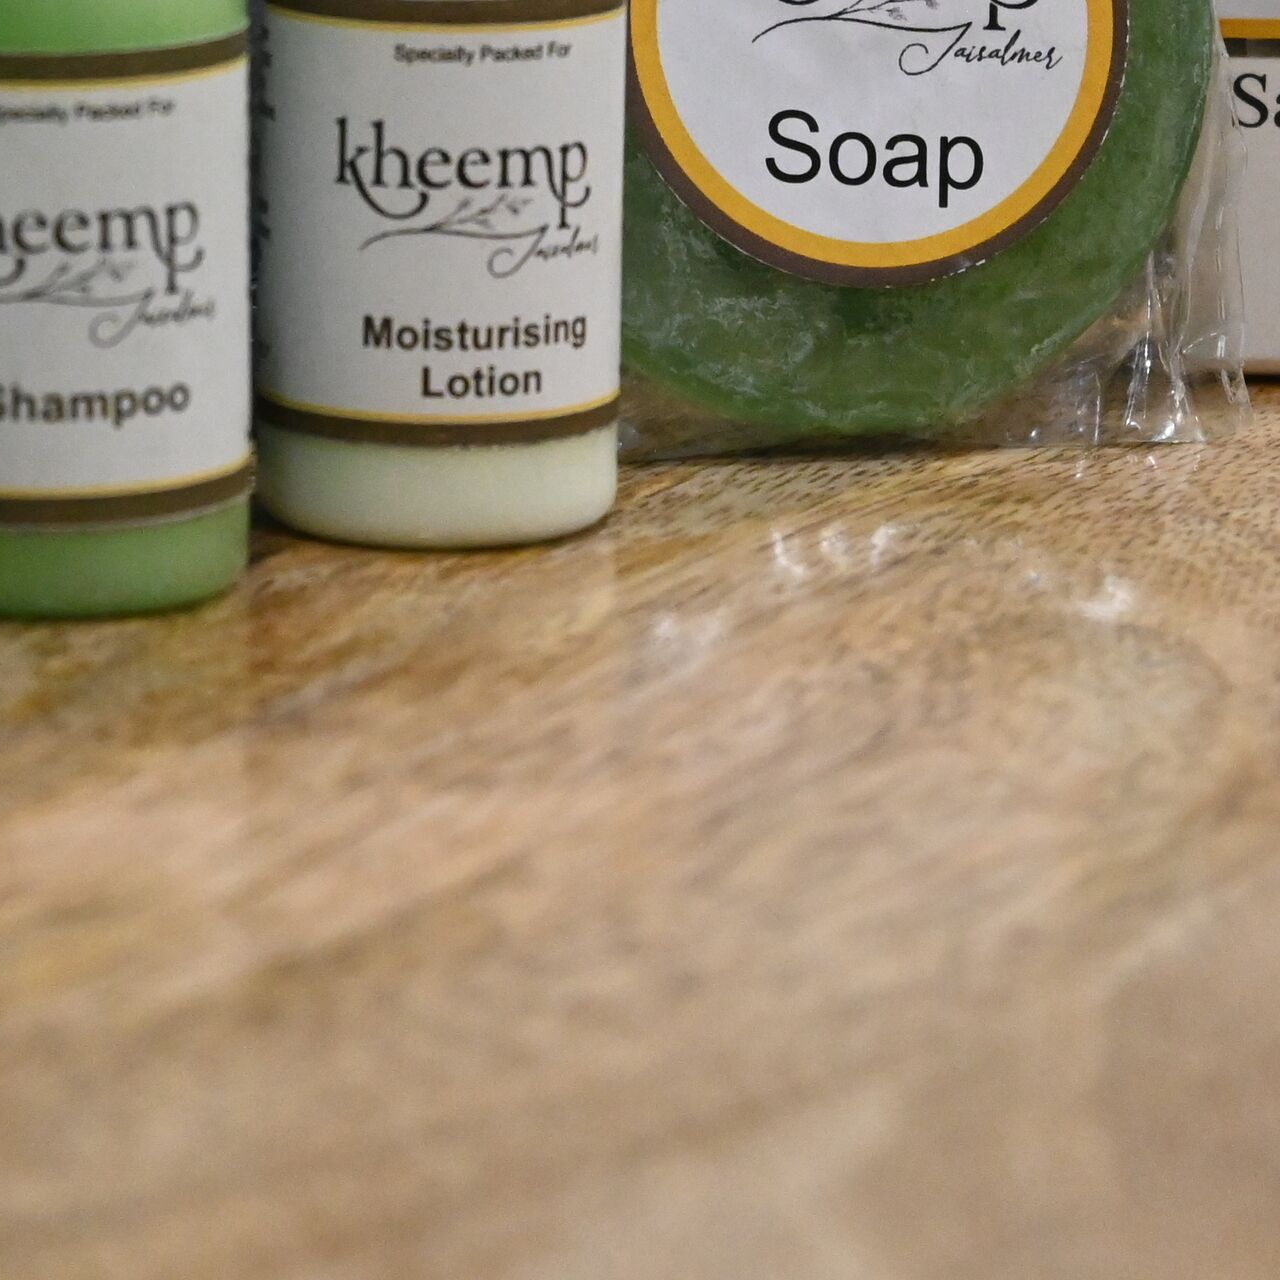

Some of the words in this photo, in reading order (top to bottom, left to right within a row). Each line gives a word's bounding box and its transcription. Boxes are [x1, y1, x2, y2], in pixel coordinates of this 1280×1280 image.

[479, 43, 543, 62] Packed
[546, 39, 573, 58] For
[897, 21, 1064, 77] Jaisalmer
[333, 114, 592, 230] kheemp
[764, 109, 985, 209] Soap
[361, 313, 588, 353] Moisturising
[420, 365, 543, 400] Lotion
